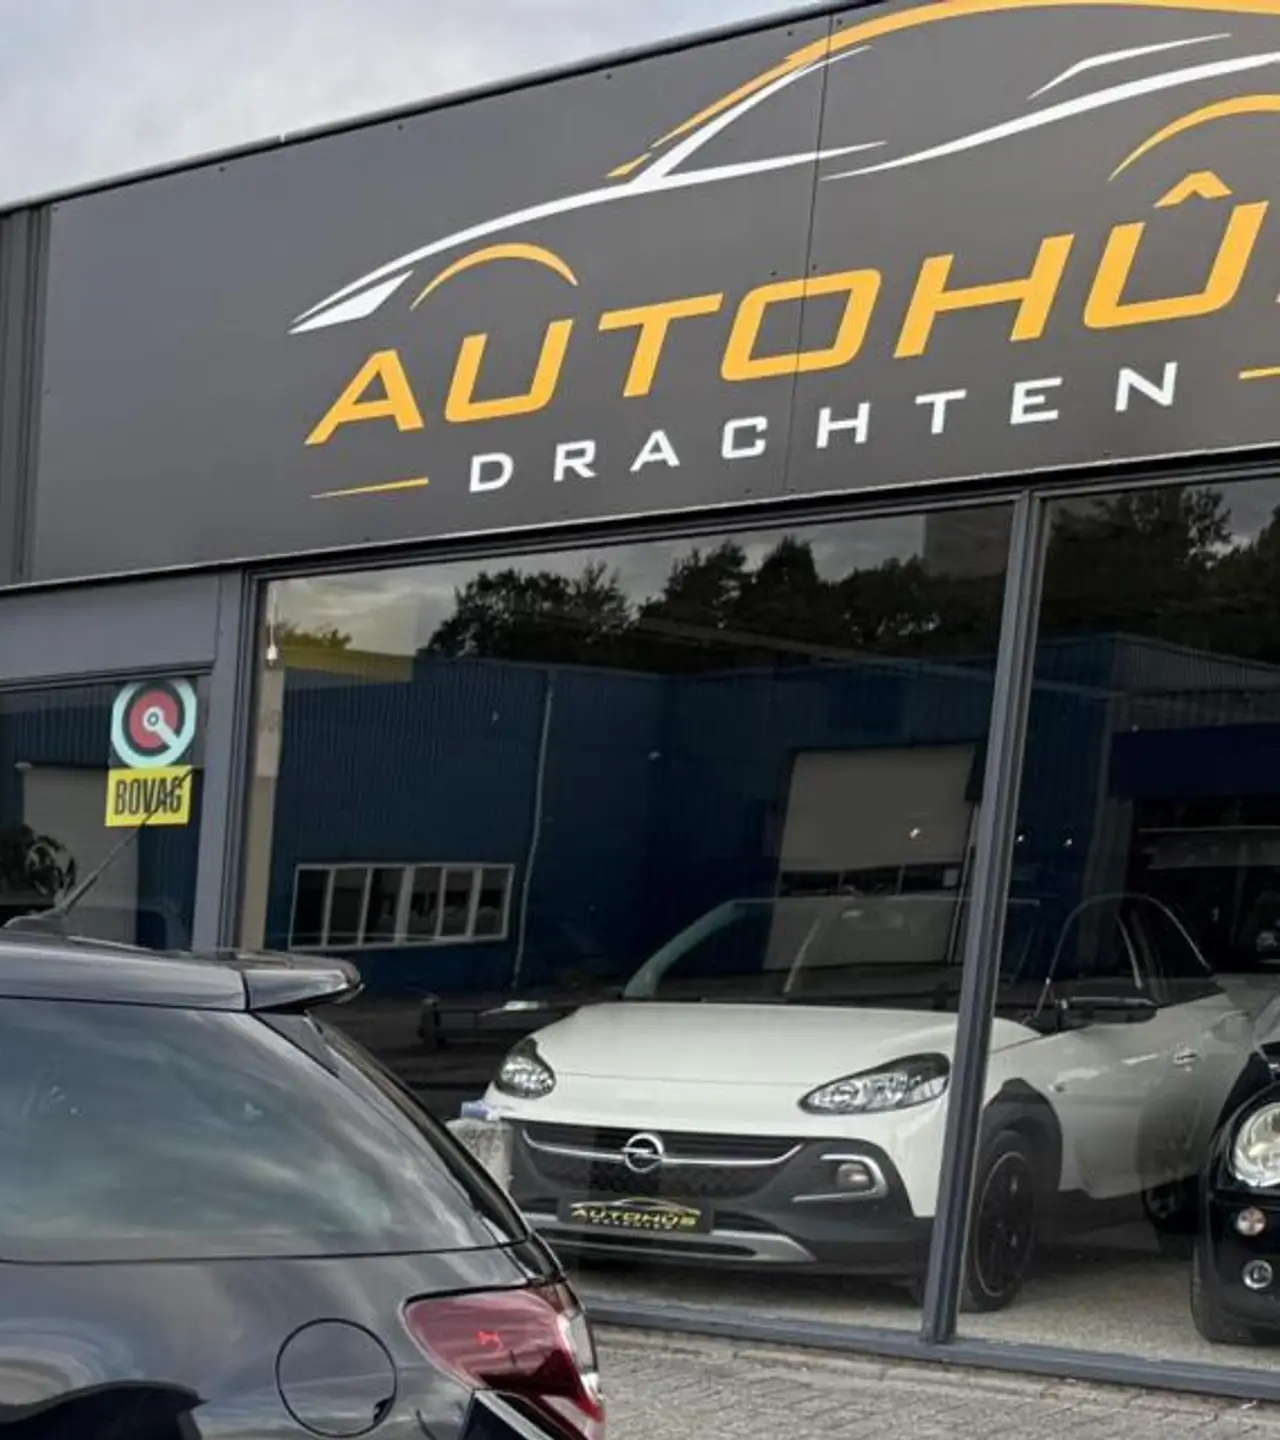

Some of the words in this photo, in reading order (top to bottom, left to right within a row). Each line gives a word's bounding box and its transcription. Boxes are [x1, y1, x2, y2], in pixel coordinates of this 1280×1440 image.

[305, 171, 1280, 446] AUTOHÛ
[468, 361, 1178, 494] DRACHTEN
[113, 775, 183, 816] BOVAG
